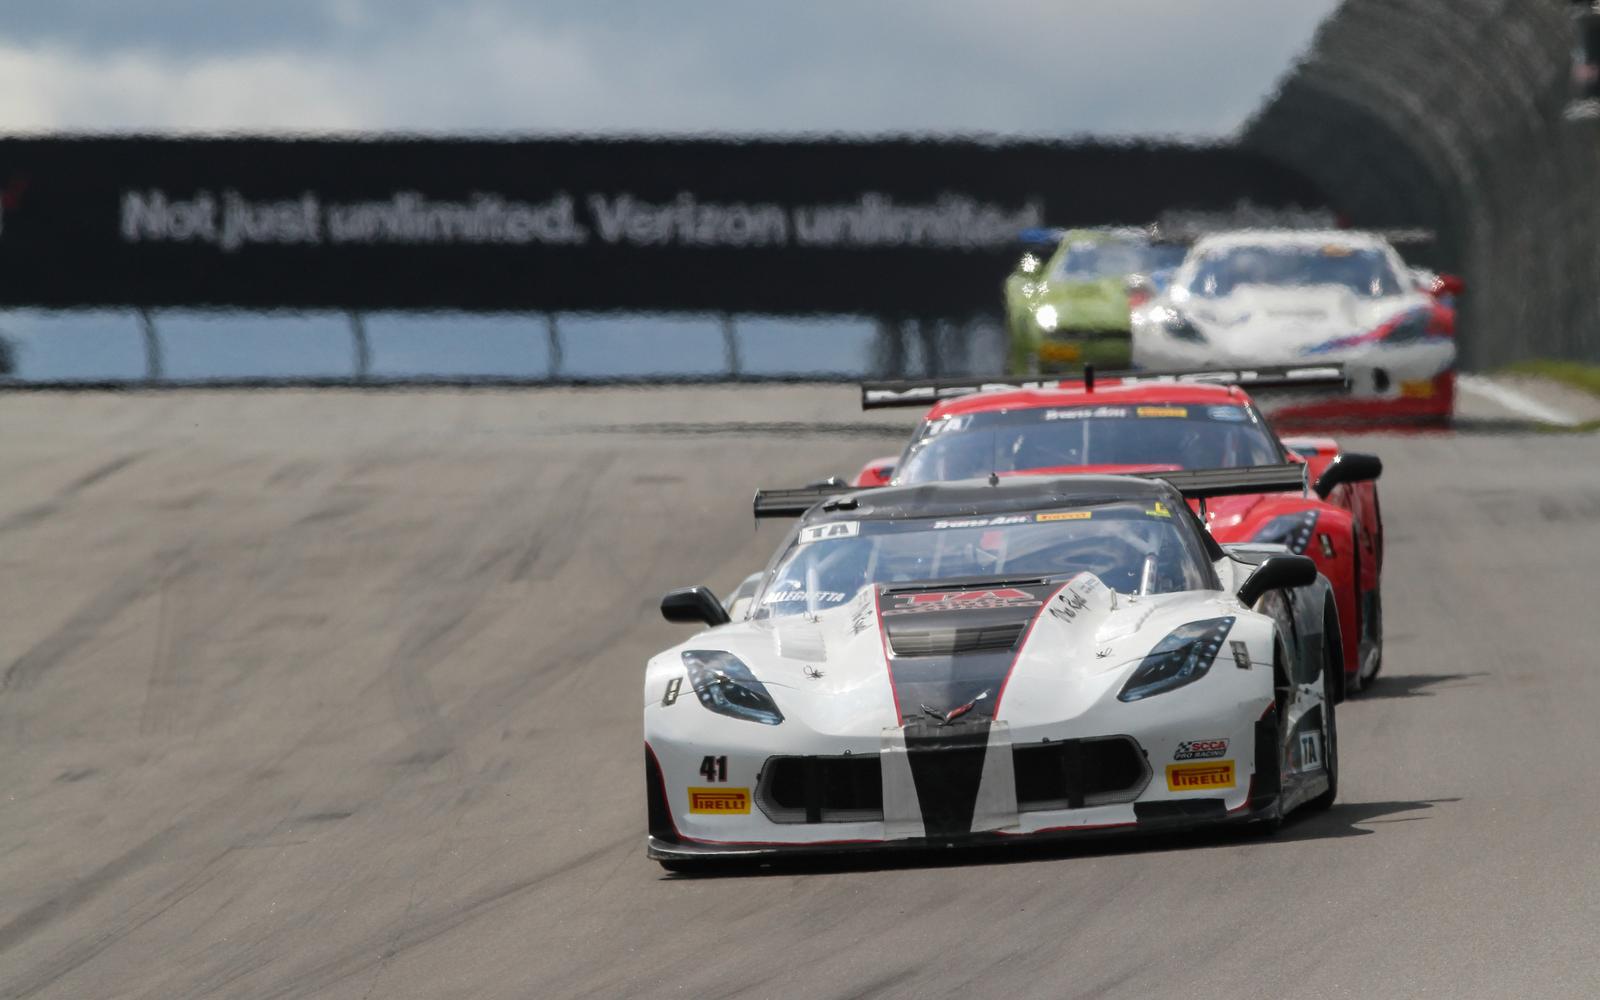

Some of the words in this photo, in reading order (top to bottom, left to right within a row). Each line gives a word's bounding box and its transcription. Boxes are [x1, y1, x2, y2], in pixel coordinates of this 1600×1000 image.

[121, 190, 217, 242] Not
[222, 189, 320, 250] just
[329, 191, 587, 244] unlimited.
[588, 191, 786, 246] Verizon
[808, 524, 849, 538] TA
[893, 588, 1036, 605] TA
[1191, 740, 1227, 751] SCCA
[1301, 736, 1318, 765] TA
[1175, 750, 1193, 760] PRO
[1194, 749, 1226, 759] RACING
[700, 755, 728, 782] 41
[1171, 766, 1231, 787] PIRELLI
[692, 793, 745, 810] PIRELLI
